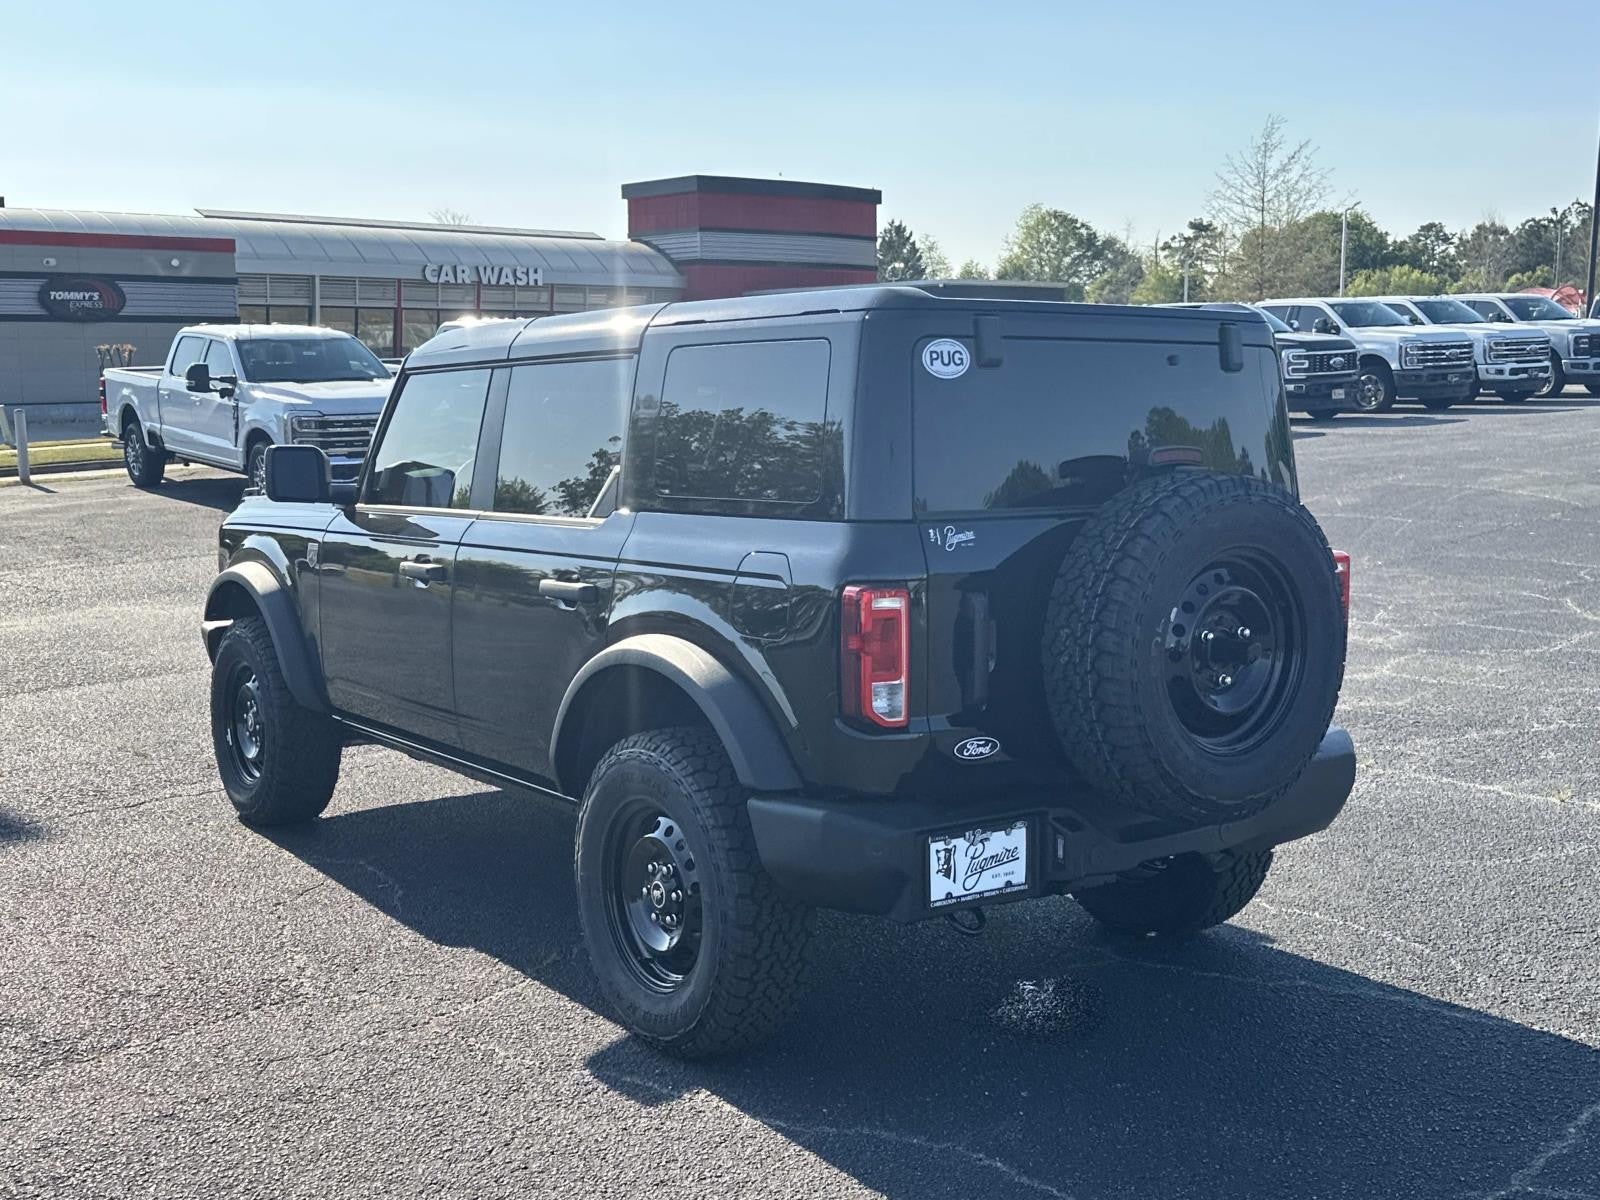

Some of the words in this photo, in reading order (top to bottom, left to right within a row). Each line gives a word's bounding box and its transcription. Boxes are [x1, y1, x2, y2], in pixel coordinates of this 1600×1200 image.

[424, 263, 471, 284] CAR
[478, 265, 543, 286] WASH
[49, 291, 100, 301] TOMMY'S
[69, 300, 103, 311] EXPRESS
[929, 350, 964, 367] PUG
[963, 740, 992, 756] Ford
[962, 838, 1020, 891] Pugmire
